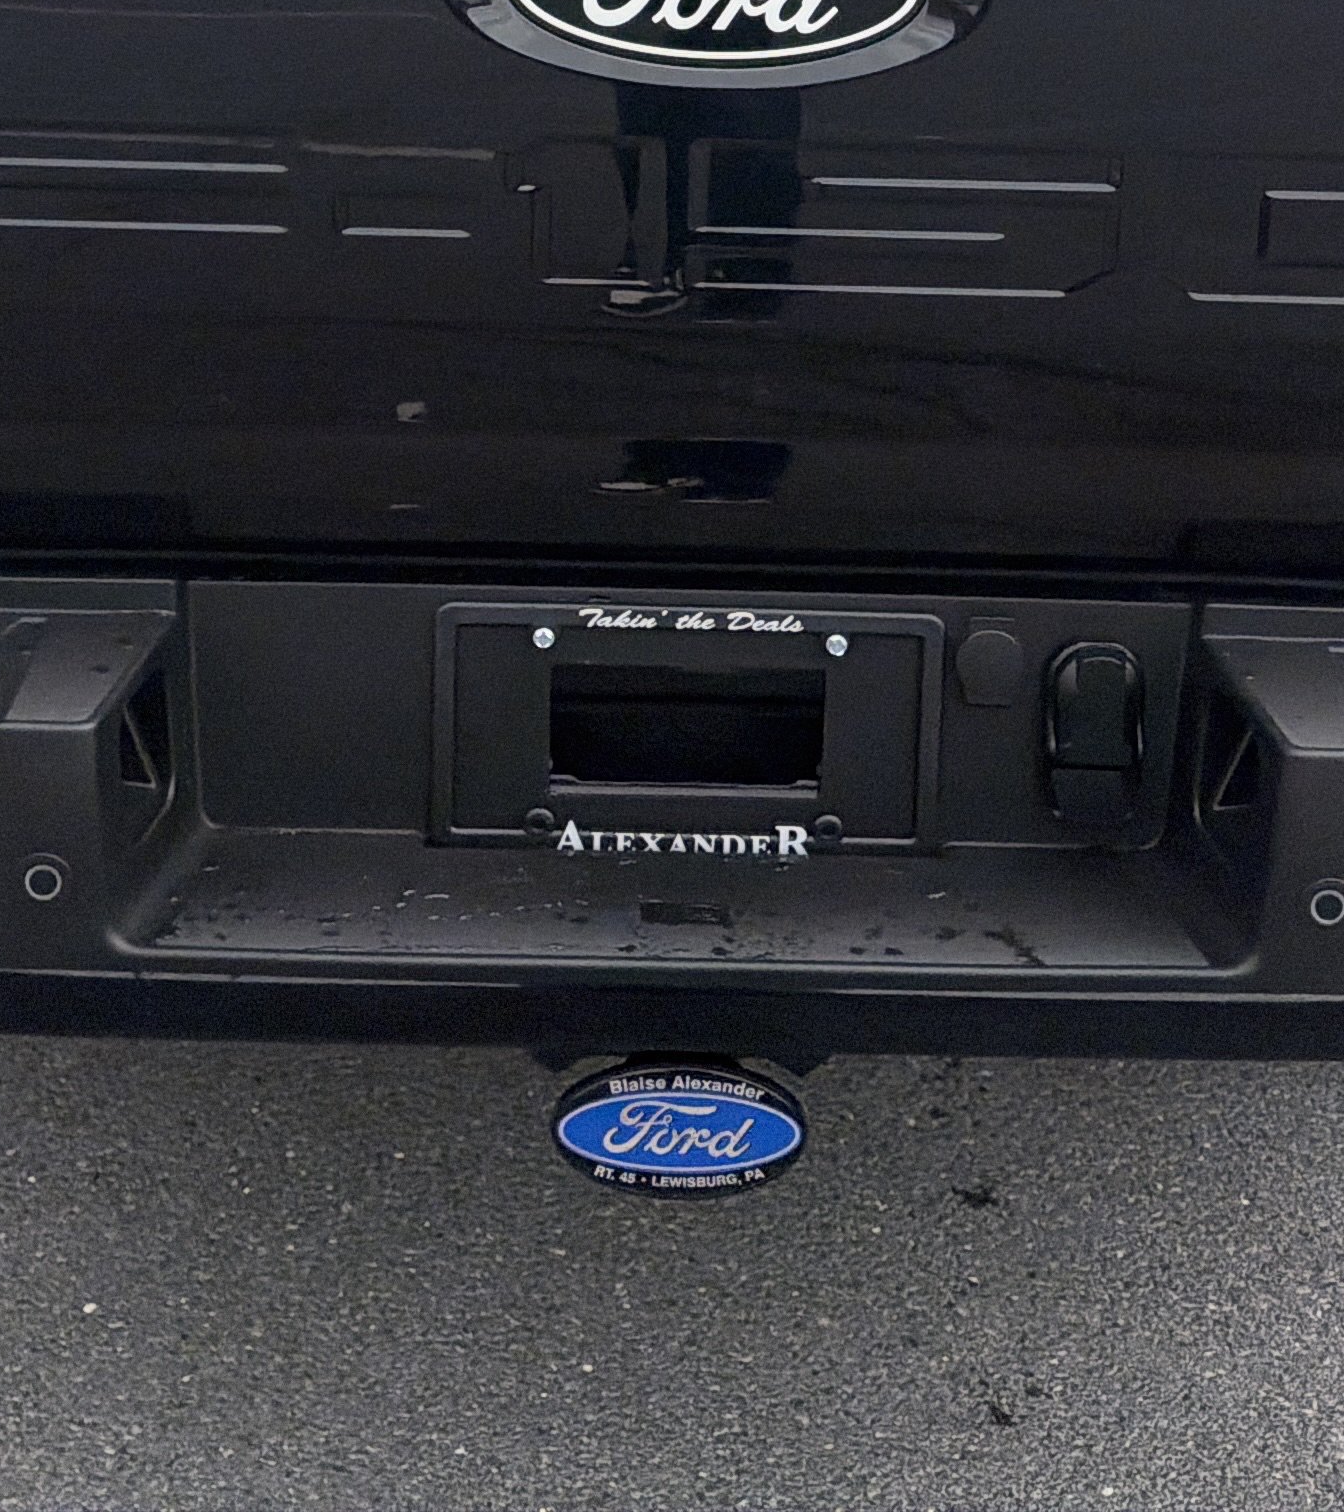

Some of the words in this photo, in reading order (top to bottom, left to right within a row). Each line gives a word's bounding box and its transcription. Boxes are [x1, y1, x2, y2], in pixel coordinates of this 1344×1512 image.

[578, 607, 669, 630] Takin'
[675, 611, 716, 630] the
[726, 611, 805, 633] Deals
[609, 1076, 667, 1095] Blaise
[672, 1075, 765, 1101] Alexander
[604, 1100, 755, 1158] Ford
[593, 1165, 615, 1181] RT.
[619, 1171, 636, 1184] 45
[651, 1173, 743, 1188] LEWISBURG,
[745, 1167, 766, 1182] PA
